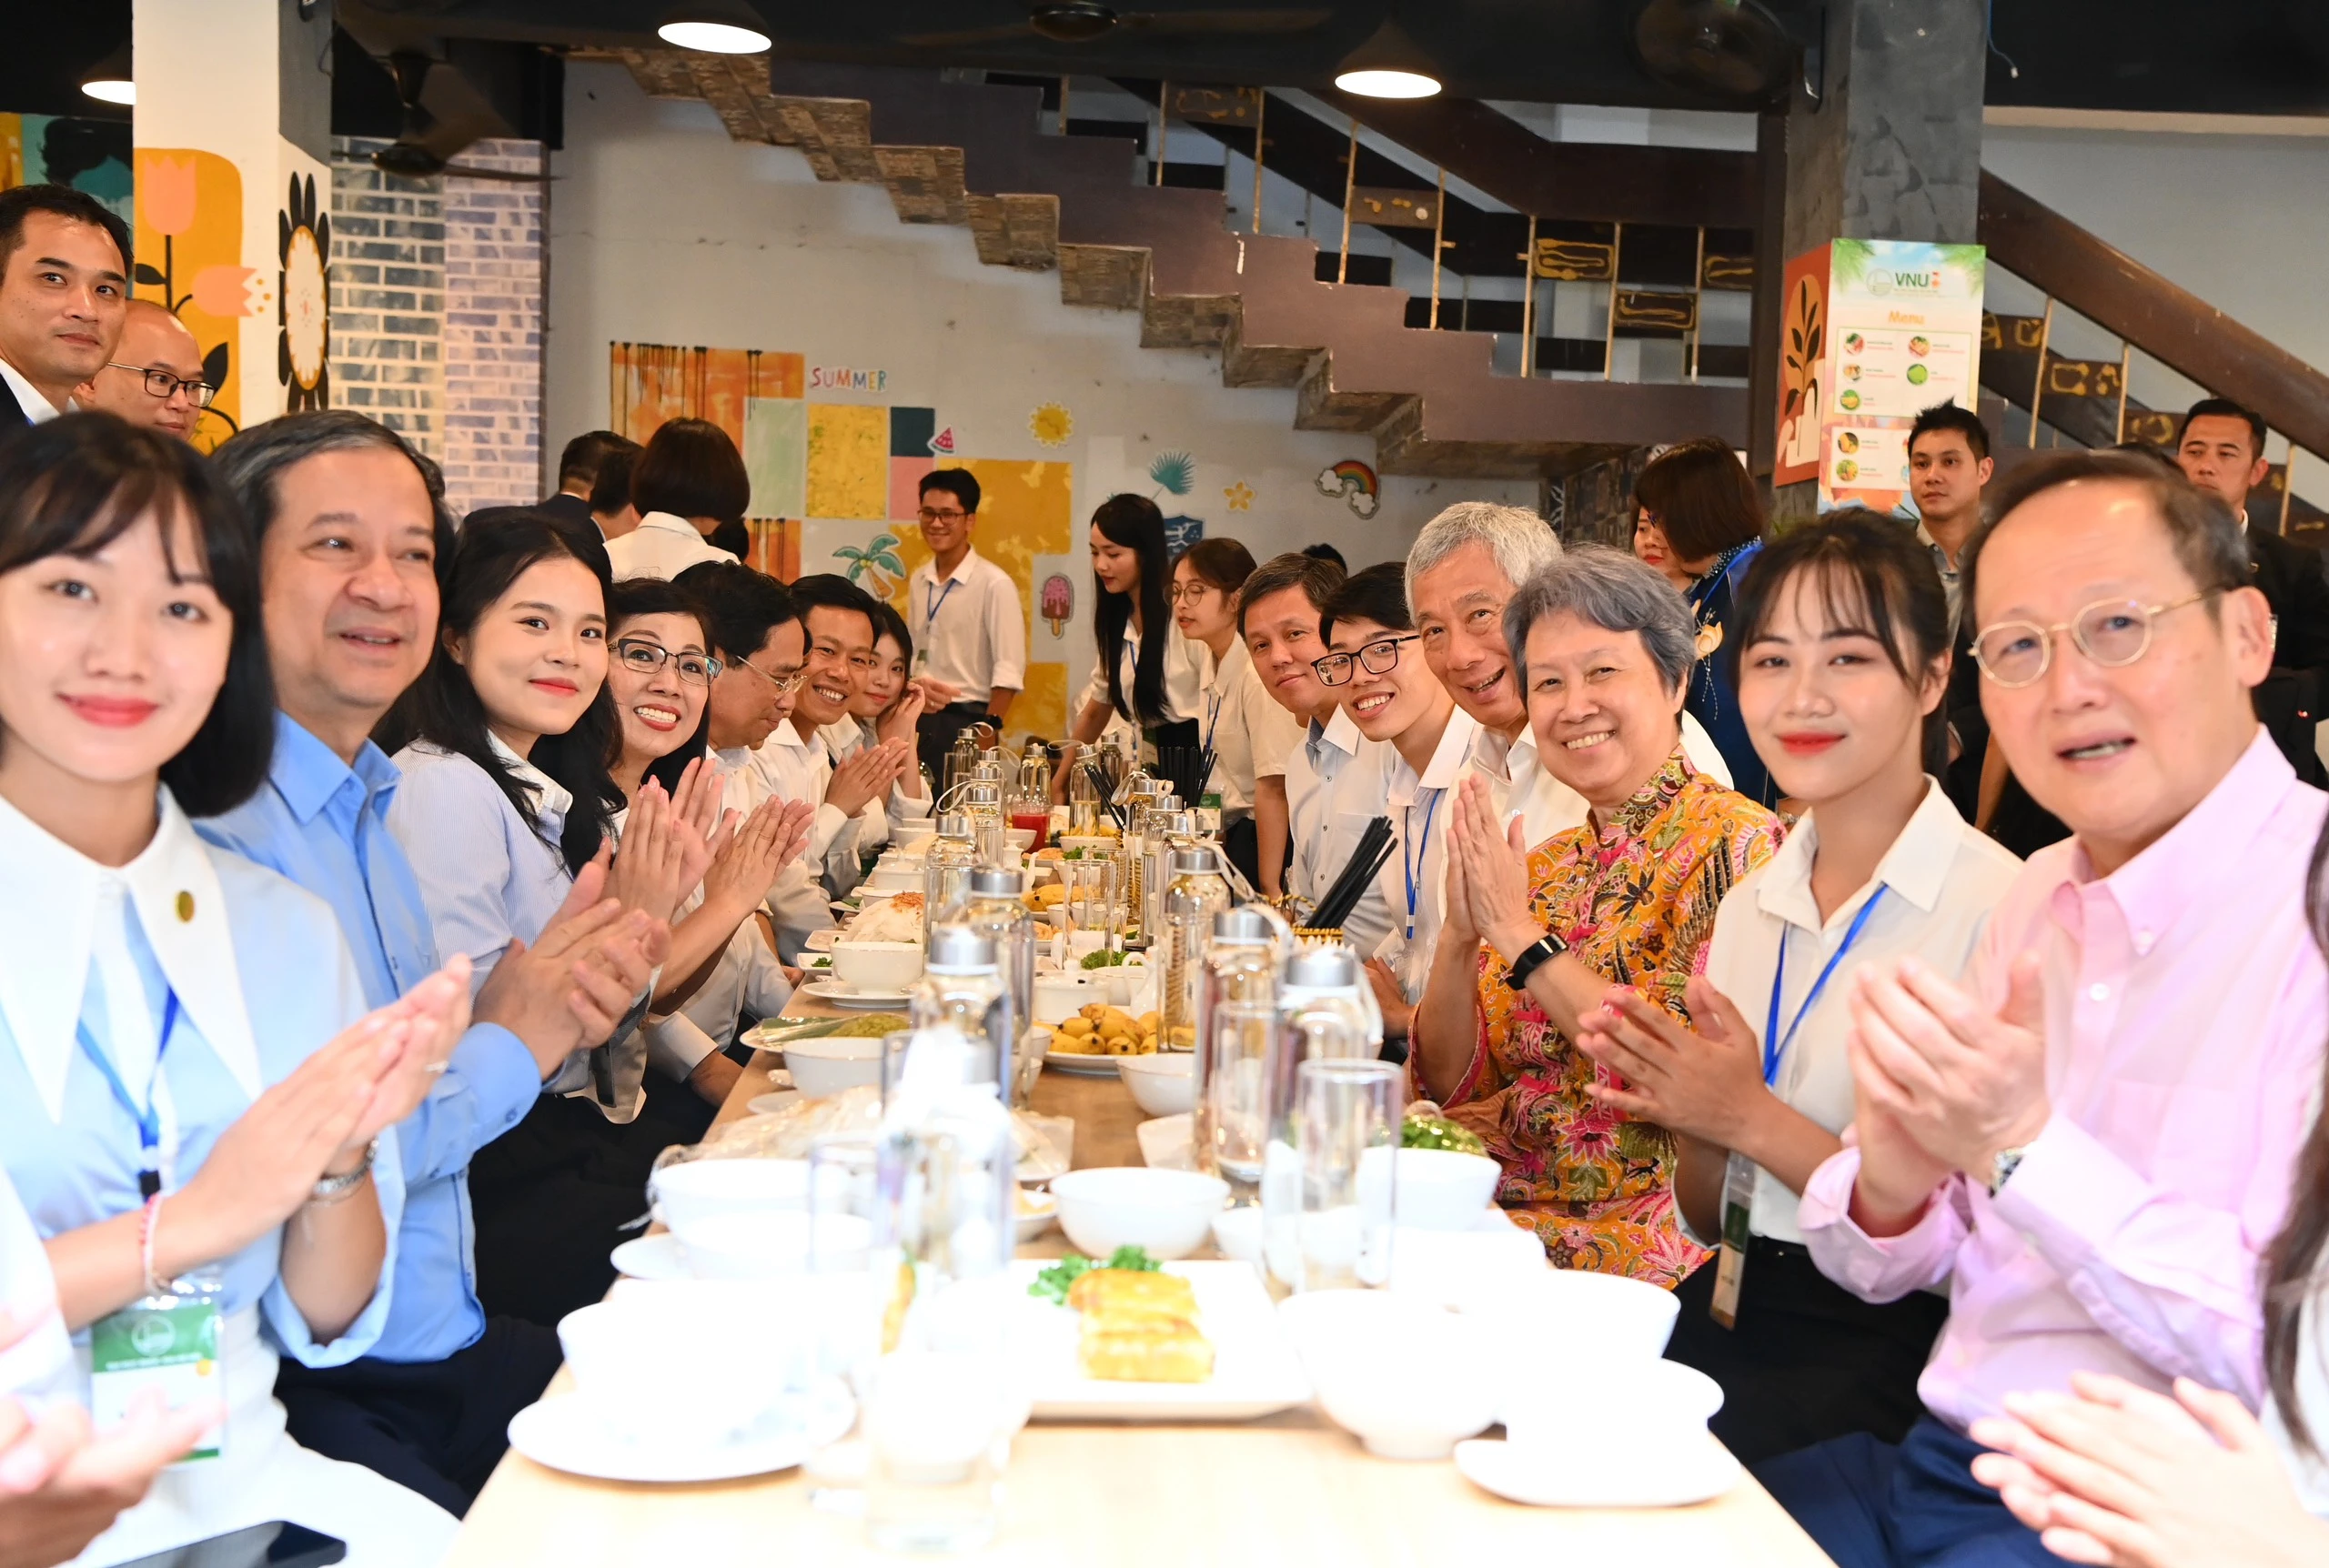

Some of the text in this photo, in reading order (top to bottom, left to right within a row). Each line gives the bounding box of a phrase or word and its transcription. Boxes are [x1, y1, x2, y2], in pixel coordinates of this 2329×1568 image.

[1894, 272, 1930, 287] VNU
[1888, 310, 1925, 325] Menu
[809, 367, 886, 391] SUMMER
